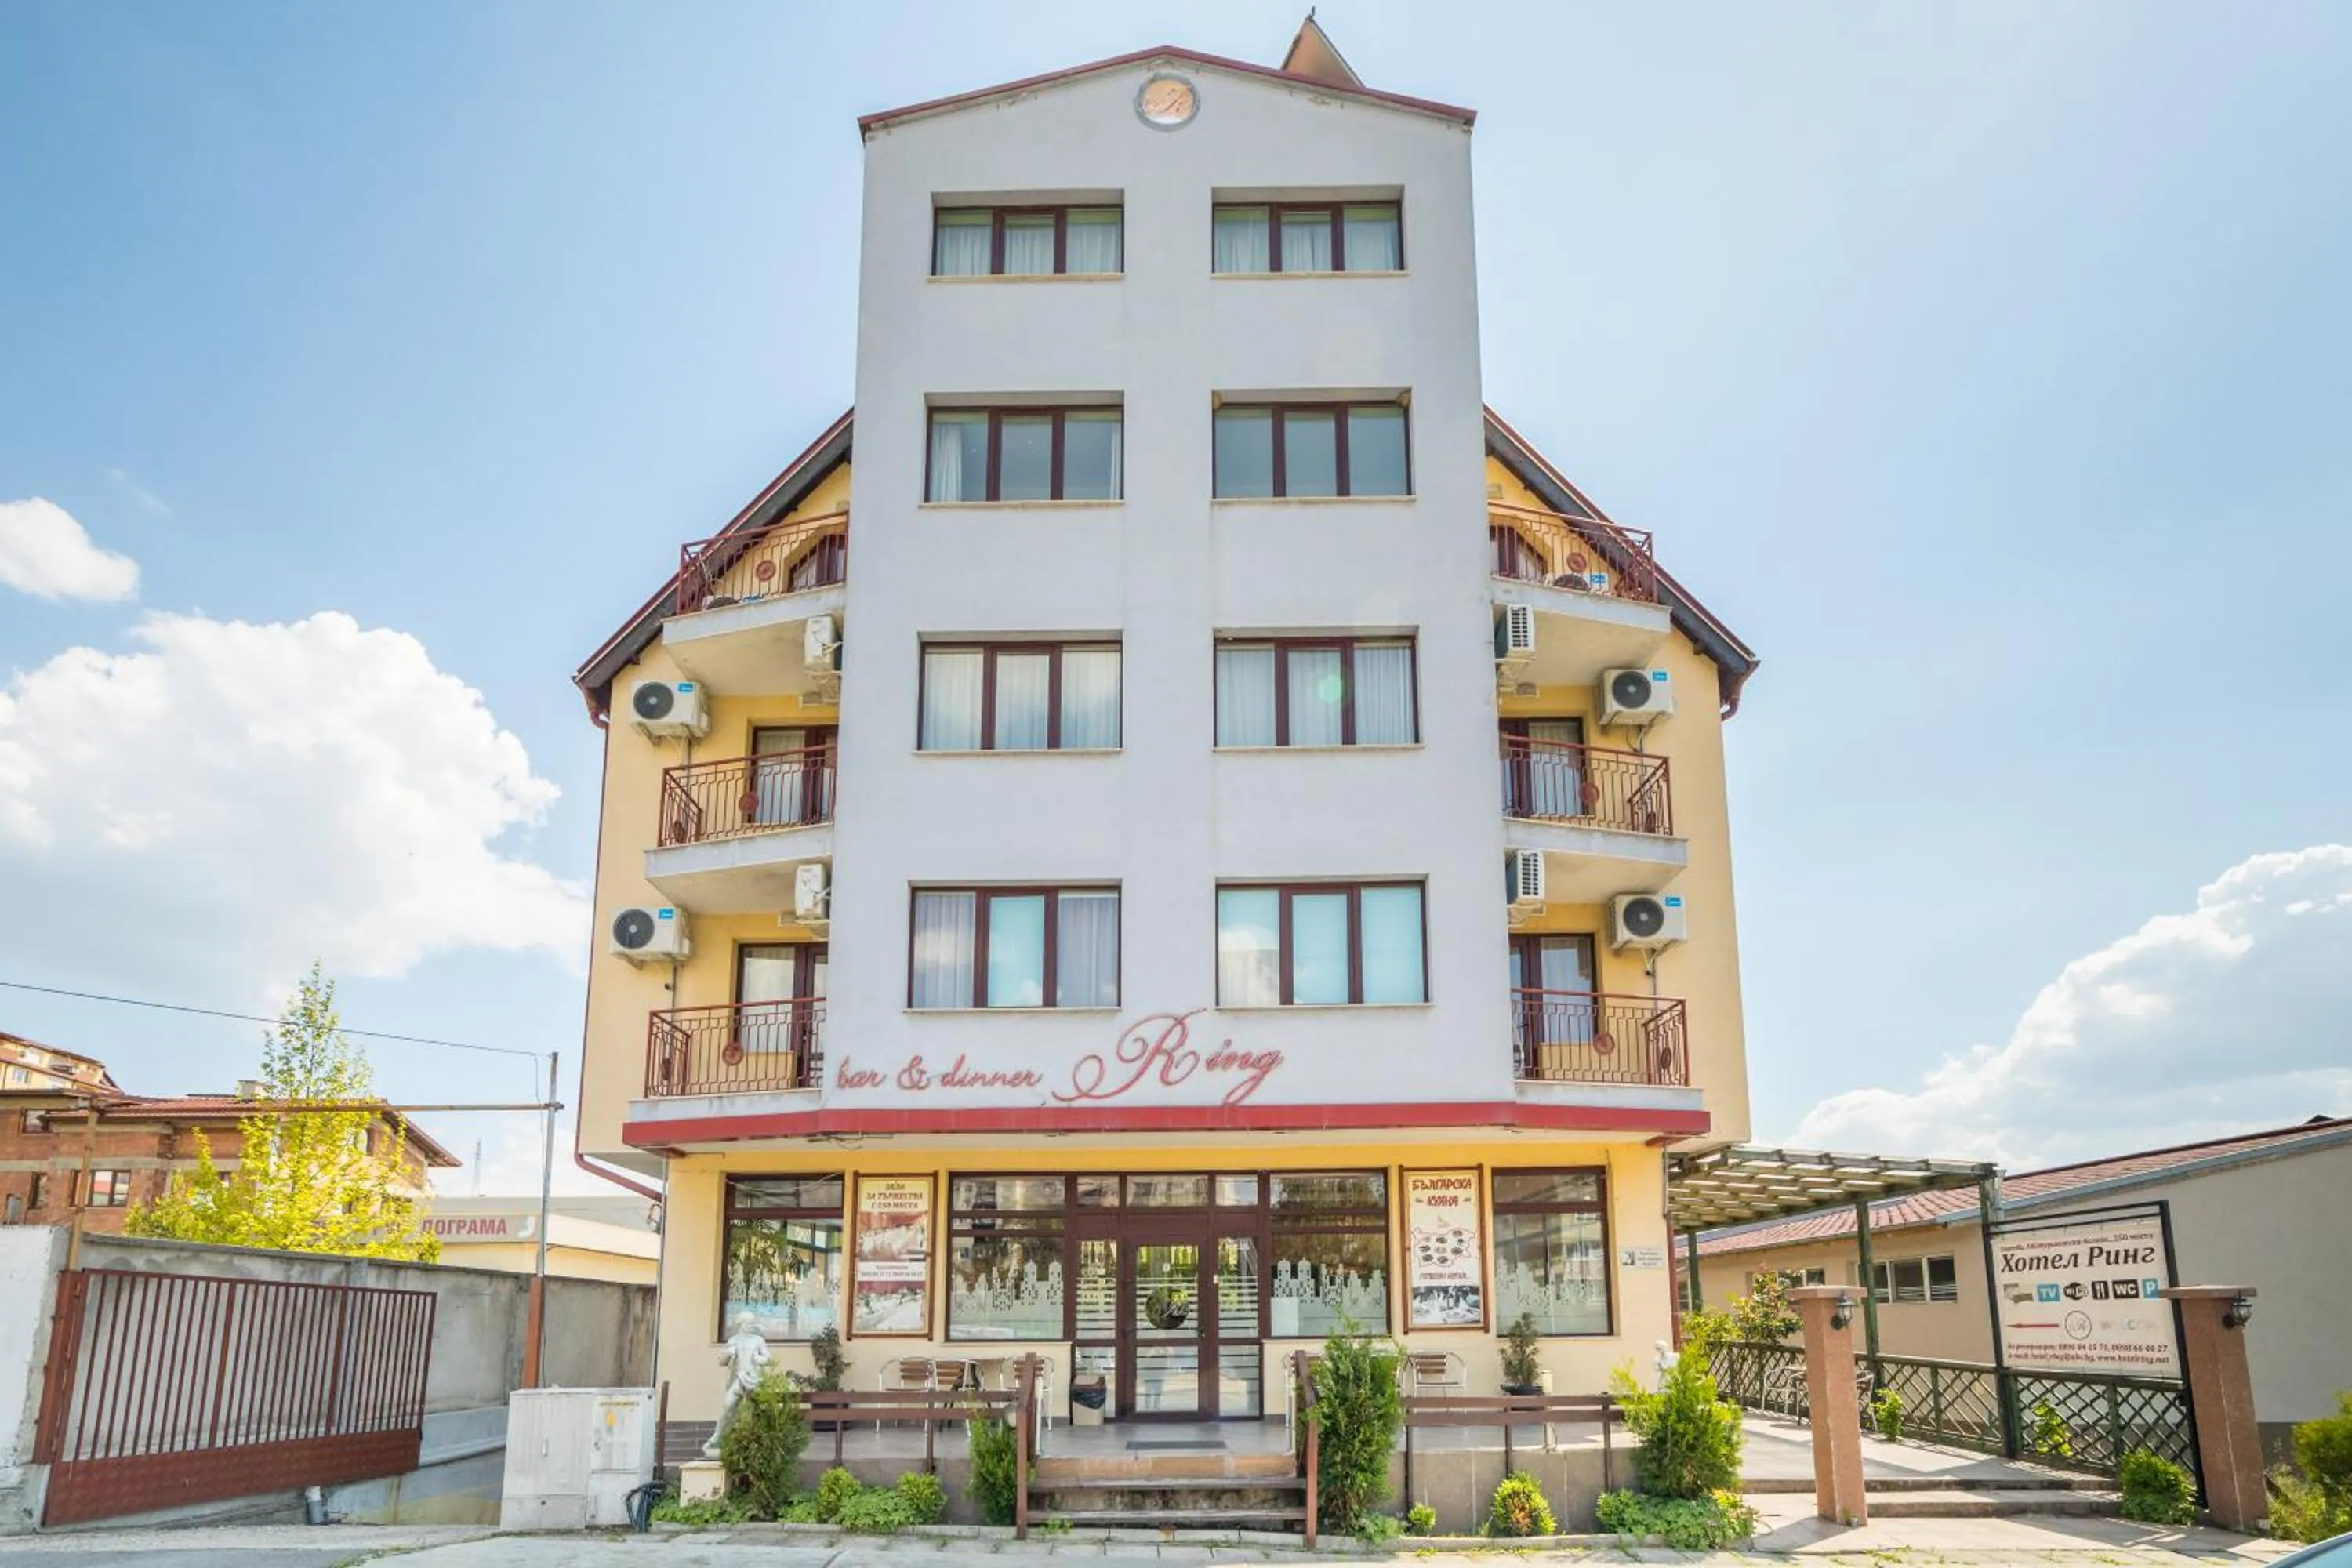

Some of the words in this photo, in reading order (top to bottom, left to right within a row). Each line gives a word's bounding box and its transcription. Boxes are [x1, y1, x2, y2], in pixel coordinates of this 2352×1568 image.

[836, 1056, 887, 1090] bar
[896, 1054, 928, 1091] &
[940, 1053, 1044, 1090] dinner
[1051, 1007, 1285, 1106] Ring
[2001, 1251, 2079, 1273] Хотел
[2087, 1245, 2156, 1268] Ринг
[2040, 1287, 2057, 1298] TV
[2114, 1283, 2136, 1295] WC
[2145, 1282, 2154, 1294] P
